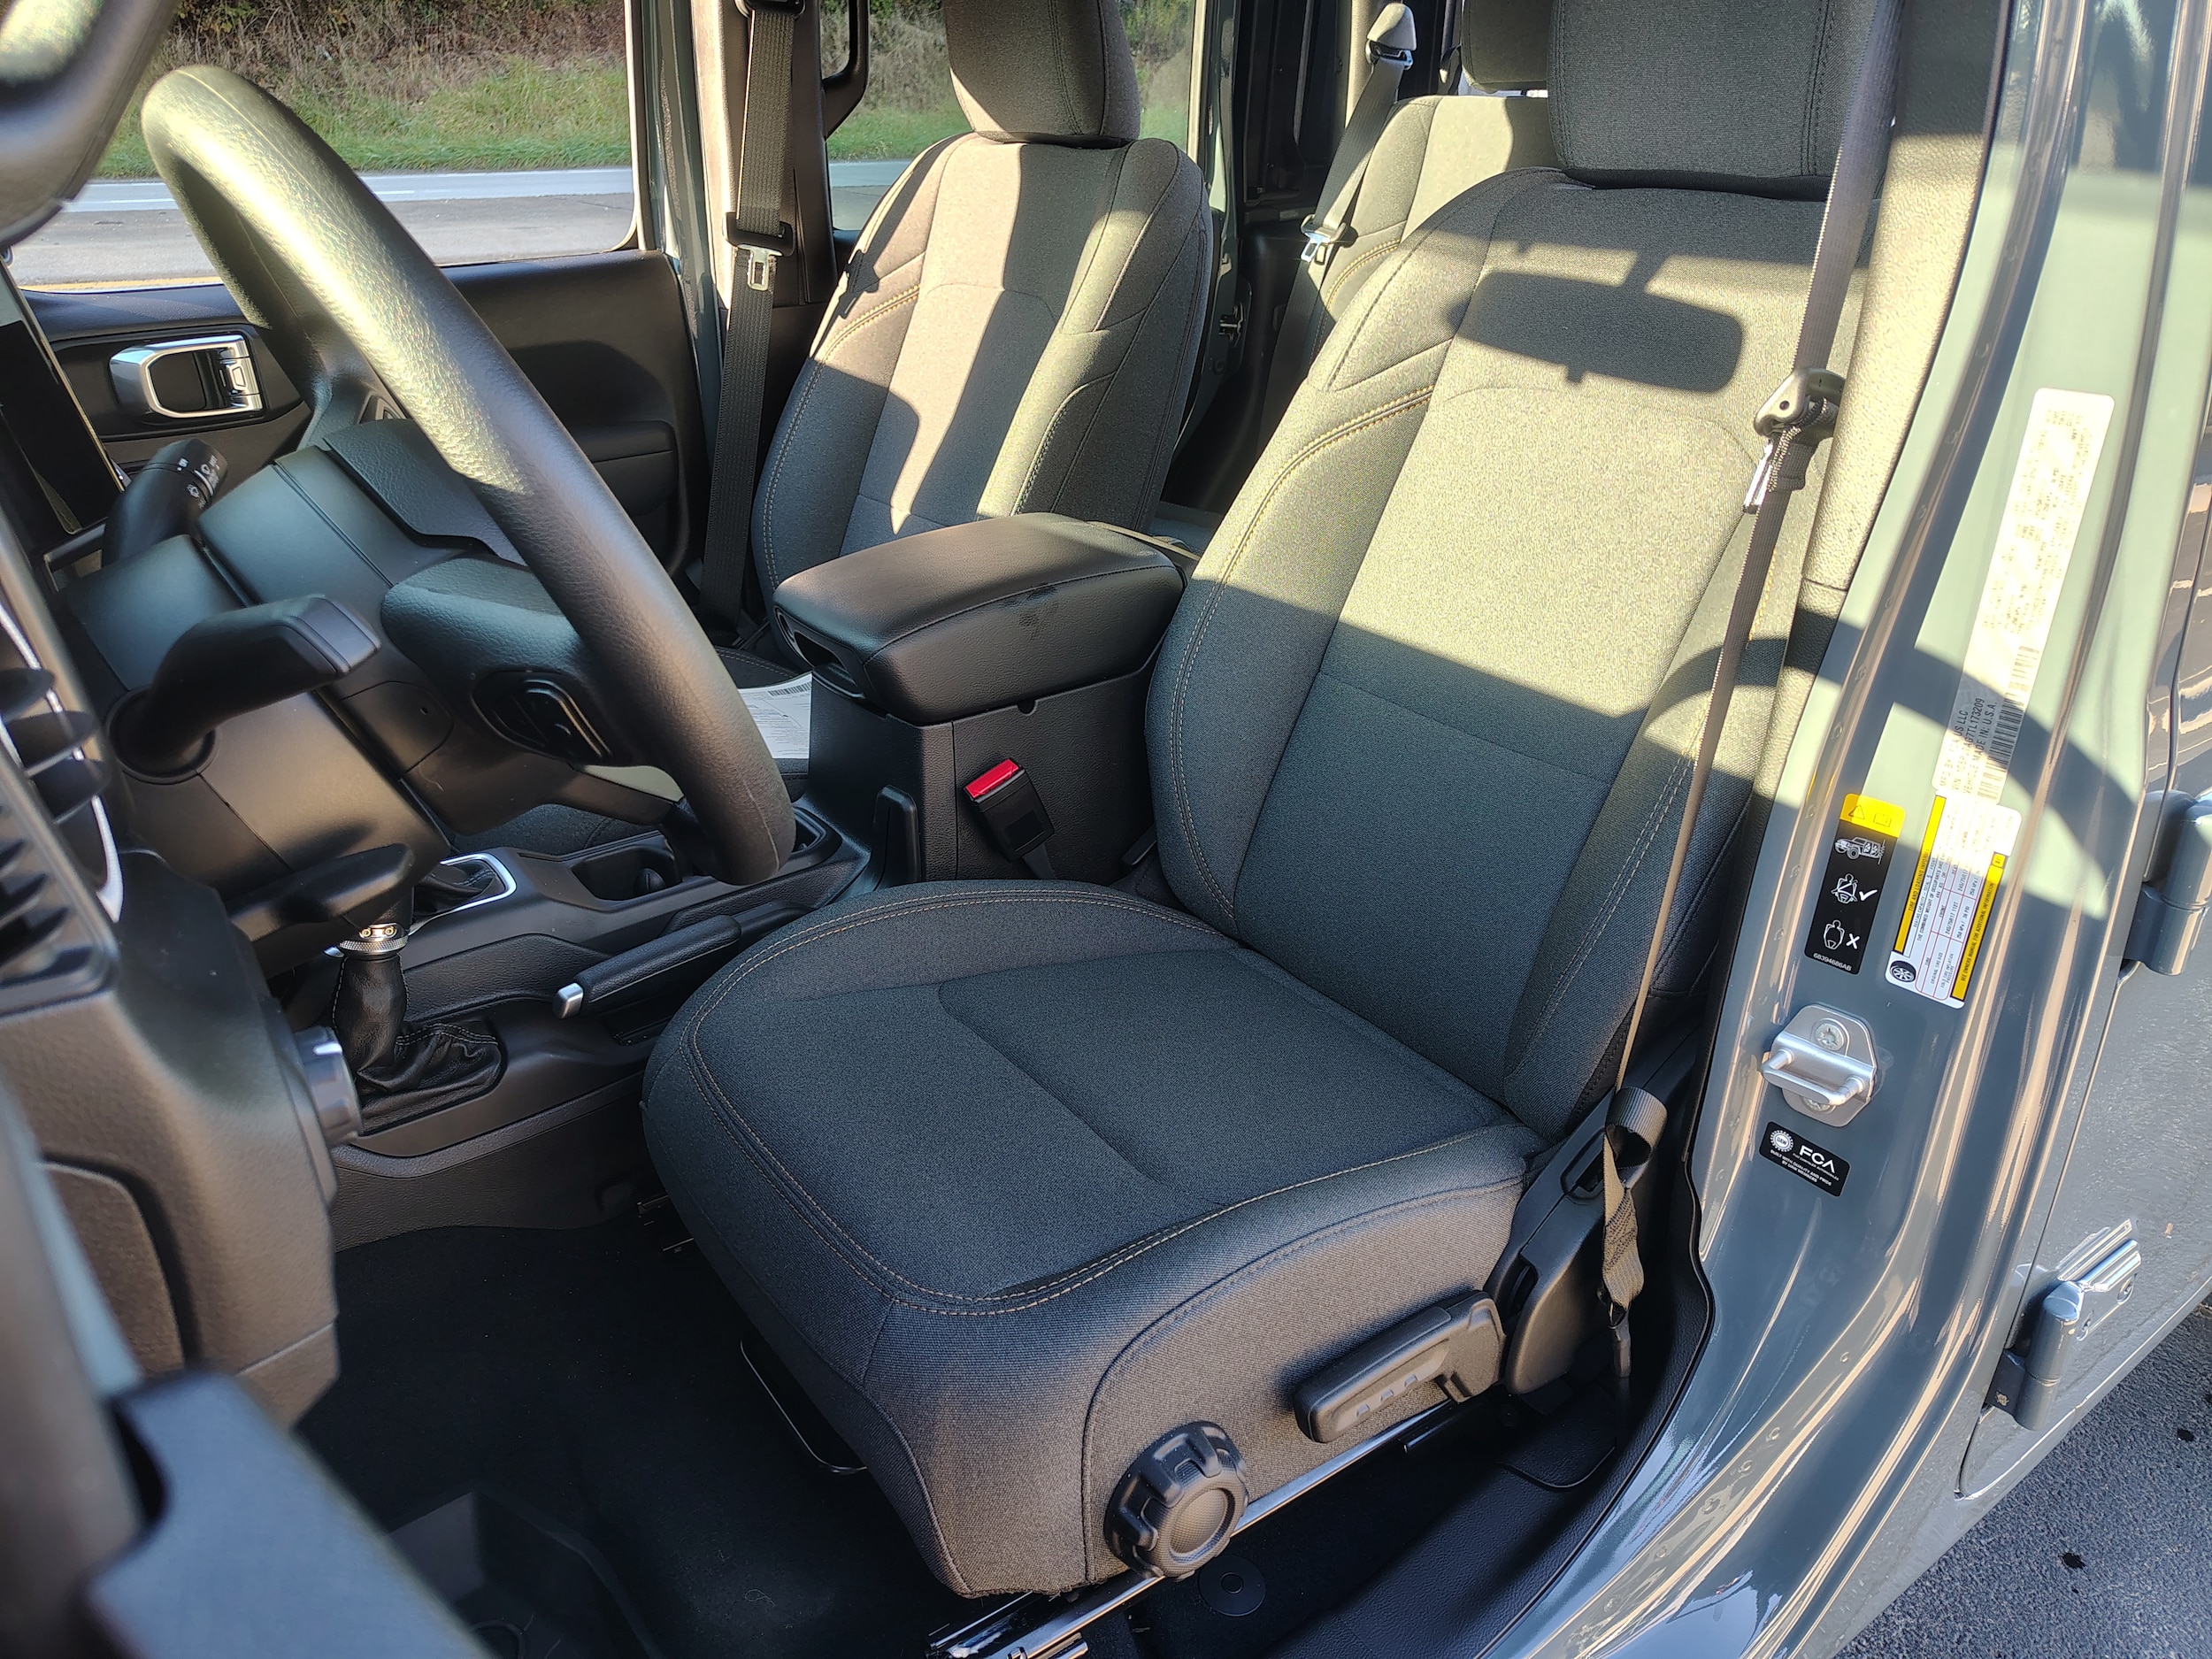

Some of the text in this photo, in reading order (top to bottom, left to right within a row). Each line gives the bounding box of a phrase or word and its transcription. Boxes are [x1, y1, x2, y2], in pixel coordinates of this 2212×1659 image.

[1955, 709, 1968, 724] LLC
[1981, 699, 1997, 726] U.S.A.
[1953, 725, 1963, 736] US
[1978, 726, 1989, 738] IN:
[1971, 739, 1985, 762] MADE
[1914, 870, 1924, 890] LOADING
[1918, 913, 1928, 933] COMBINED
[1931, 870, 1940, 892] OCCUPANTS
[1975, 910, 1985, 932] ADDITIONAL
[1981, 882, 1993, 909] INFORMATION
[1944, 912, 1955, 934] 245/75R17
[1800, 1145, 1834, 1173] FCA
